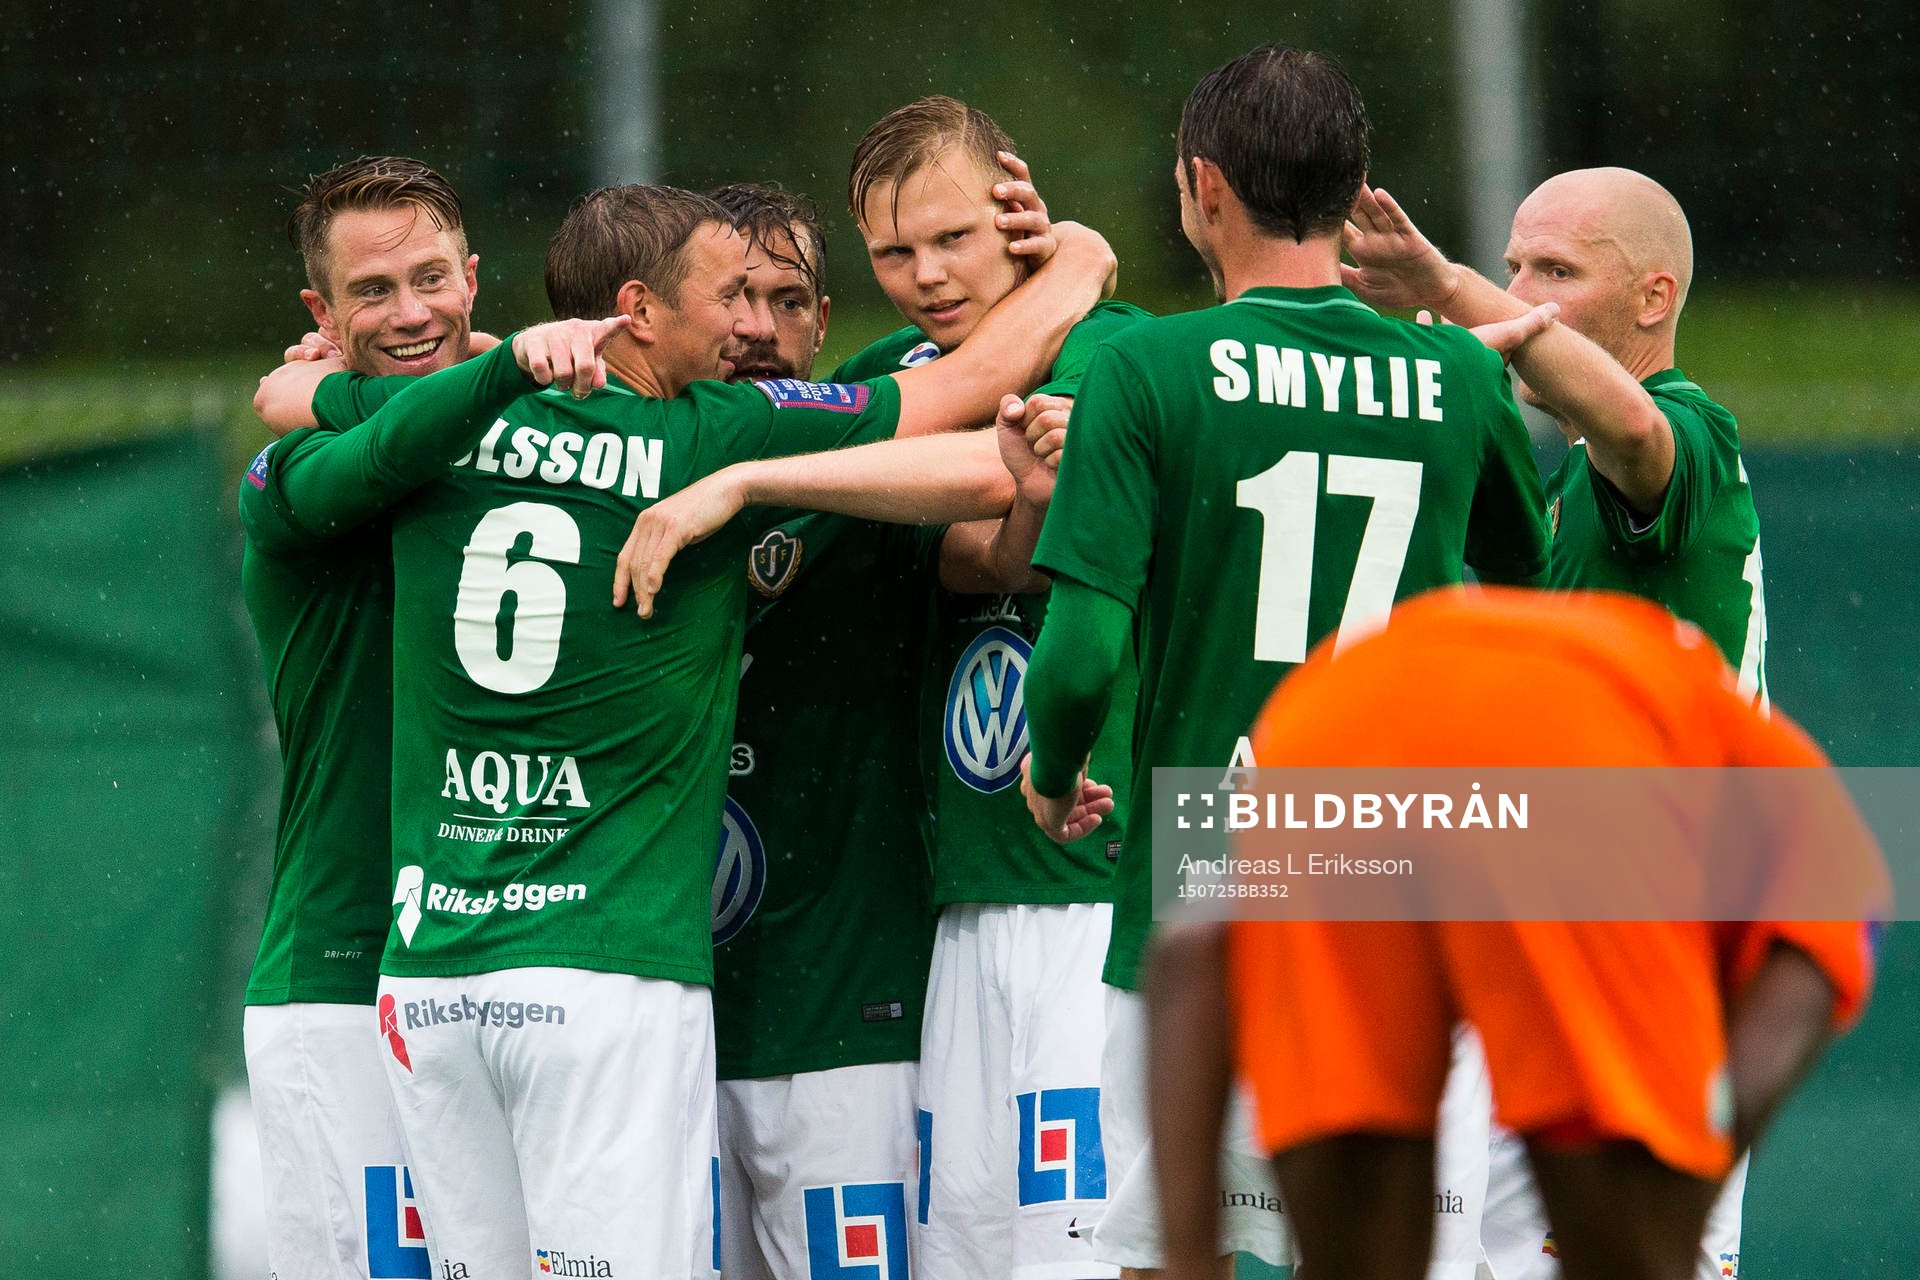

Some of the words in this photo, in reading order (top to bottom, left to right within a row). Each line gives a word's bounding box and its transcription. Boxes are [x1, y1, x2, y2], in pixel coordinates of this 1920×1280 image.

[1209, 338, 1444, 423] SMYLIE
[454, 417, 664, 499] LSSON
[1236, 450, 1424, 664] 17
[453, 501, 581, 694] 6
[441, 748, 591, 814] AQUA
[437, 822, 496, 843] DINNER
[426, 882, 588, 916] Riksbggen
[323, 950, 363, 959] DRI-FIT
[404, 993, 567, 1031] Riksbyggen
[1218, 1190, 1284, 1214] lmia
[550, 1250, 613, 1279] Elmia
